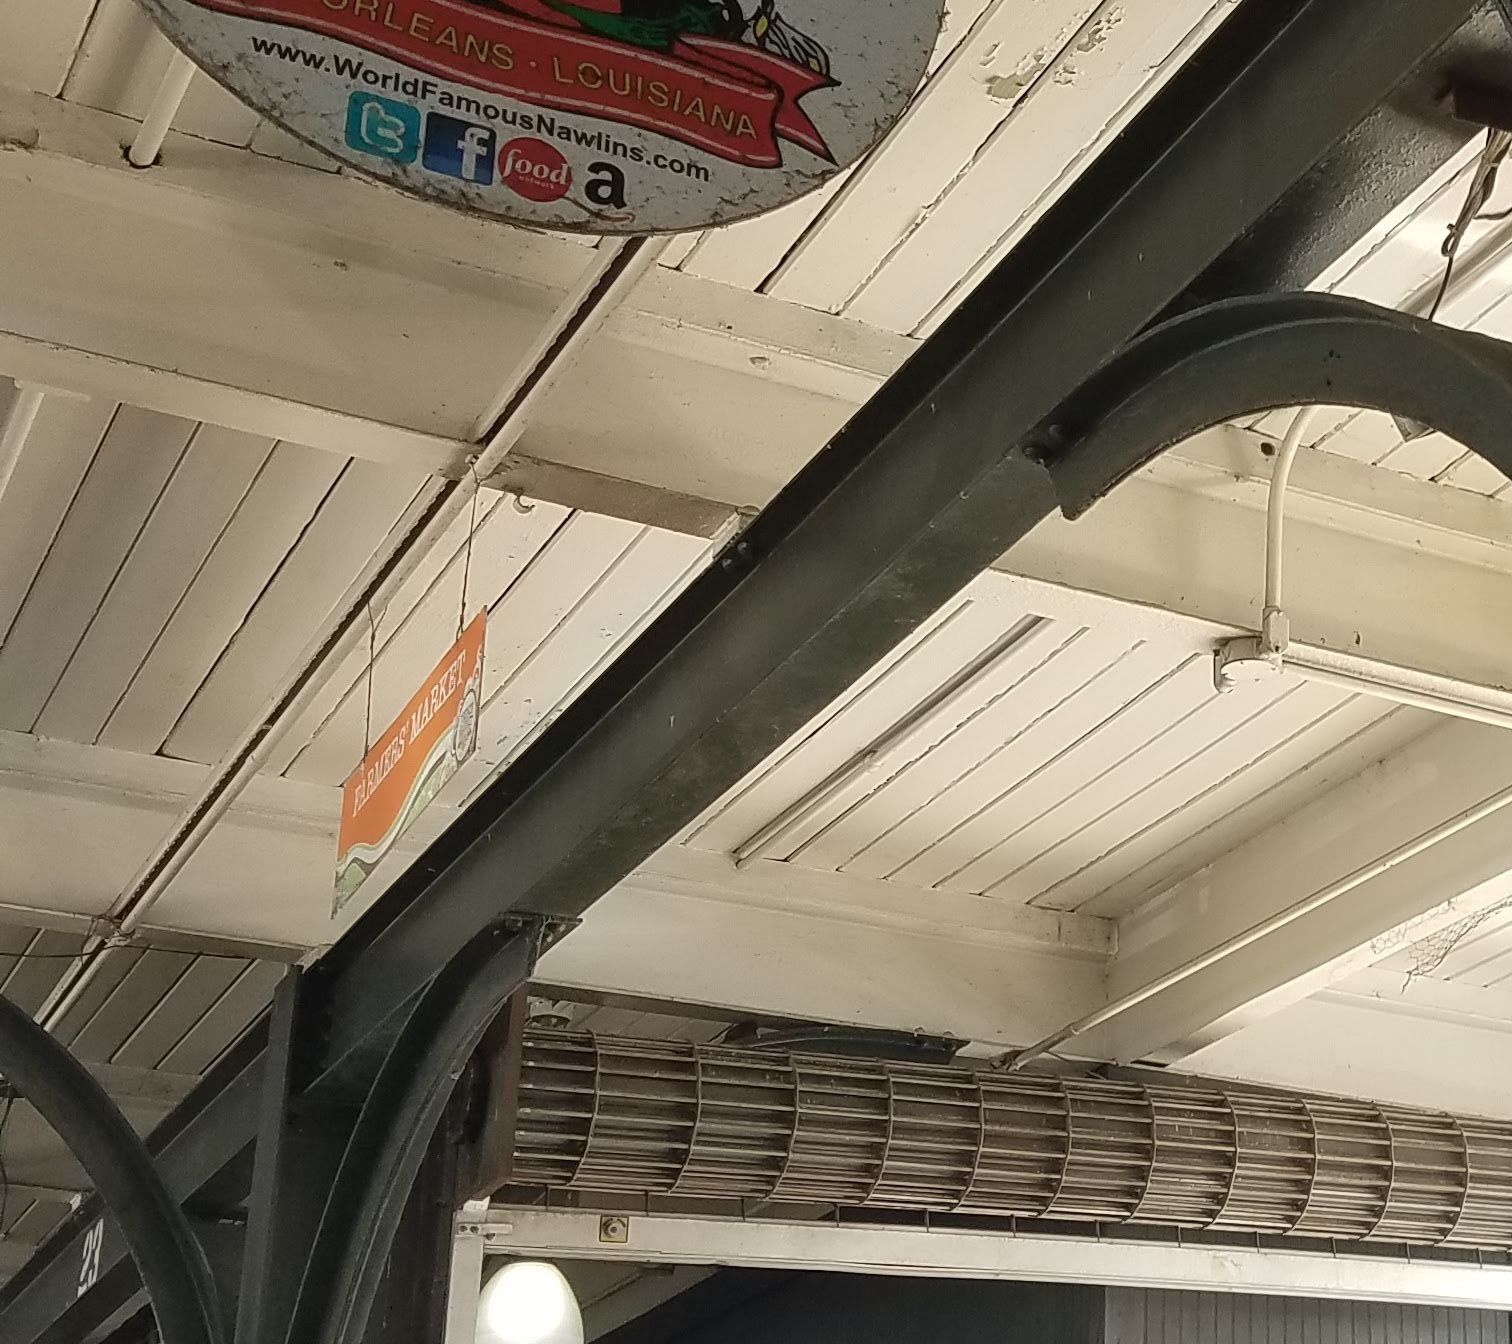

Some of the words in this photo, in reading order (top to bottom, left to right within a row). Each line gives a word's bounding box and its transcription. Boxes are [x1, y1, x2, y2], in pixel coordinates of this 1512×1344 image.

[251, 34, 711, 184] www.WorldFamousNawlins.com
[550, 56, 759, 141] LOUISIANA
[503, 148, 570, 186] food
[352, 721, 410, 818] FARMERS'
[408, 649, 466, 745] MARKET
